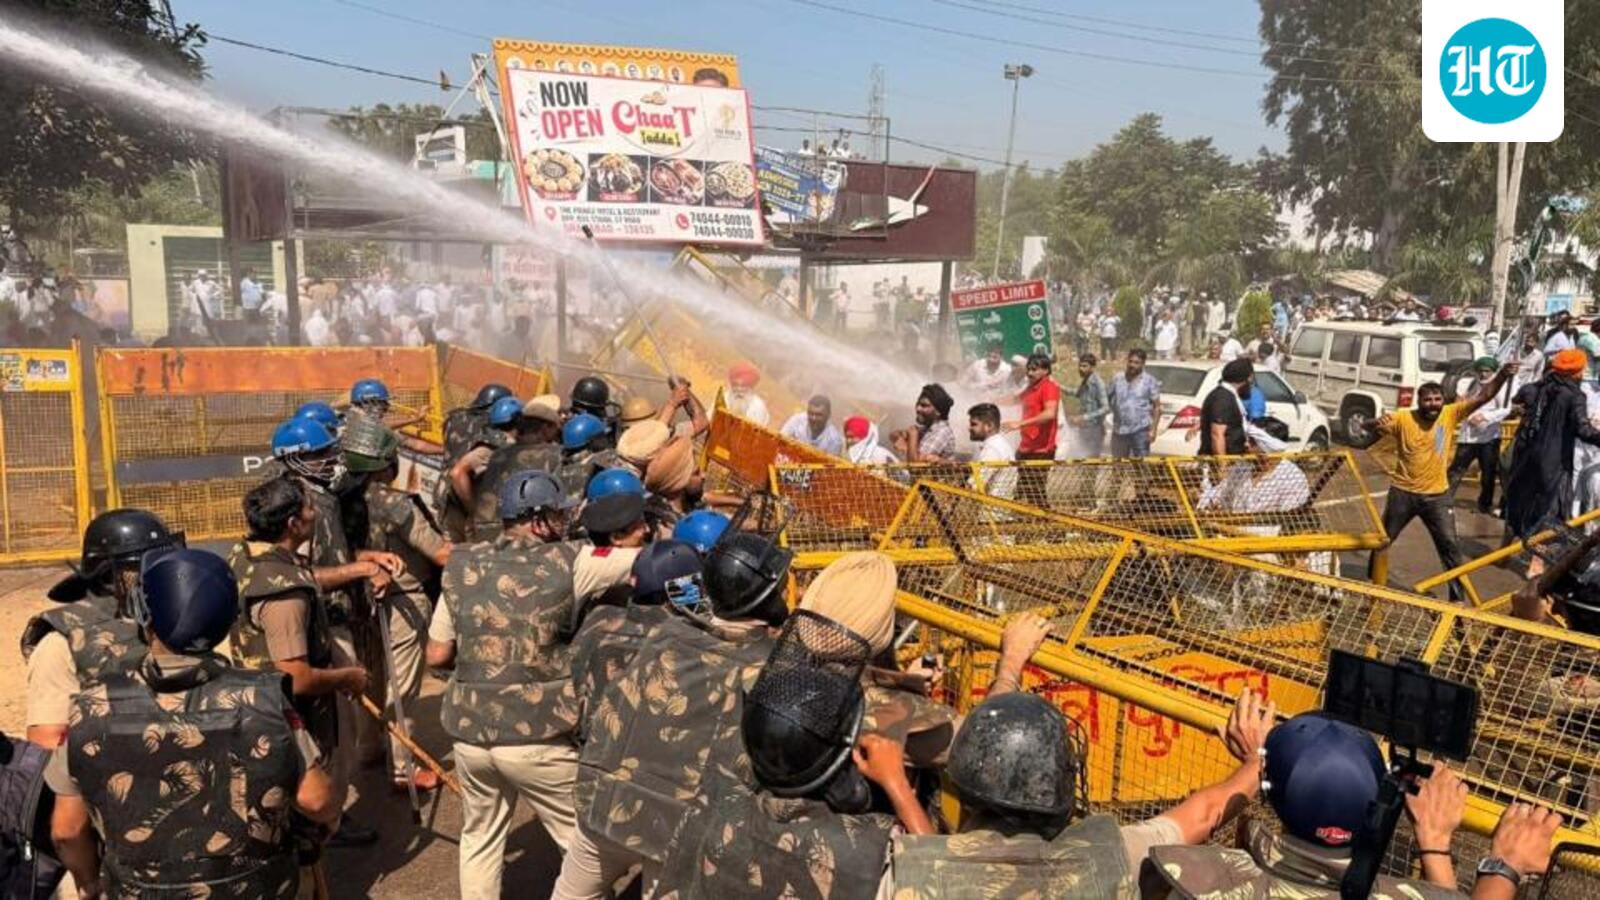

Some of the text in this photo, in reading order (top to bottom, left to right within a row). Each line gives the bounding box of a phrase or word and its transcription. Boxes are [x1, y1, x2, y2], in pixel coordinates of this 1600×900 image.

[540, 81, 588, 107] NOW
[541, 108, 604, 139] OPEN
[958, 284, 1038, 307] SPEED LIMIT
